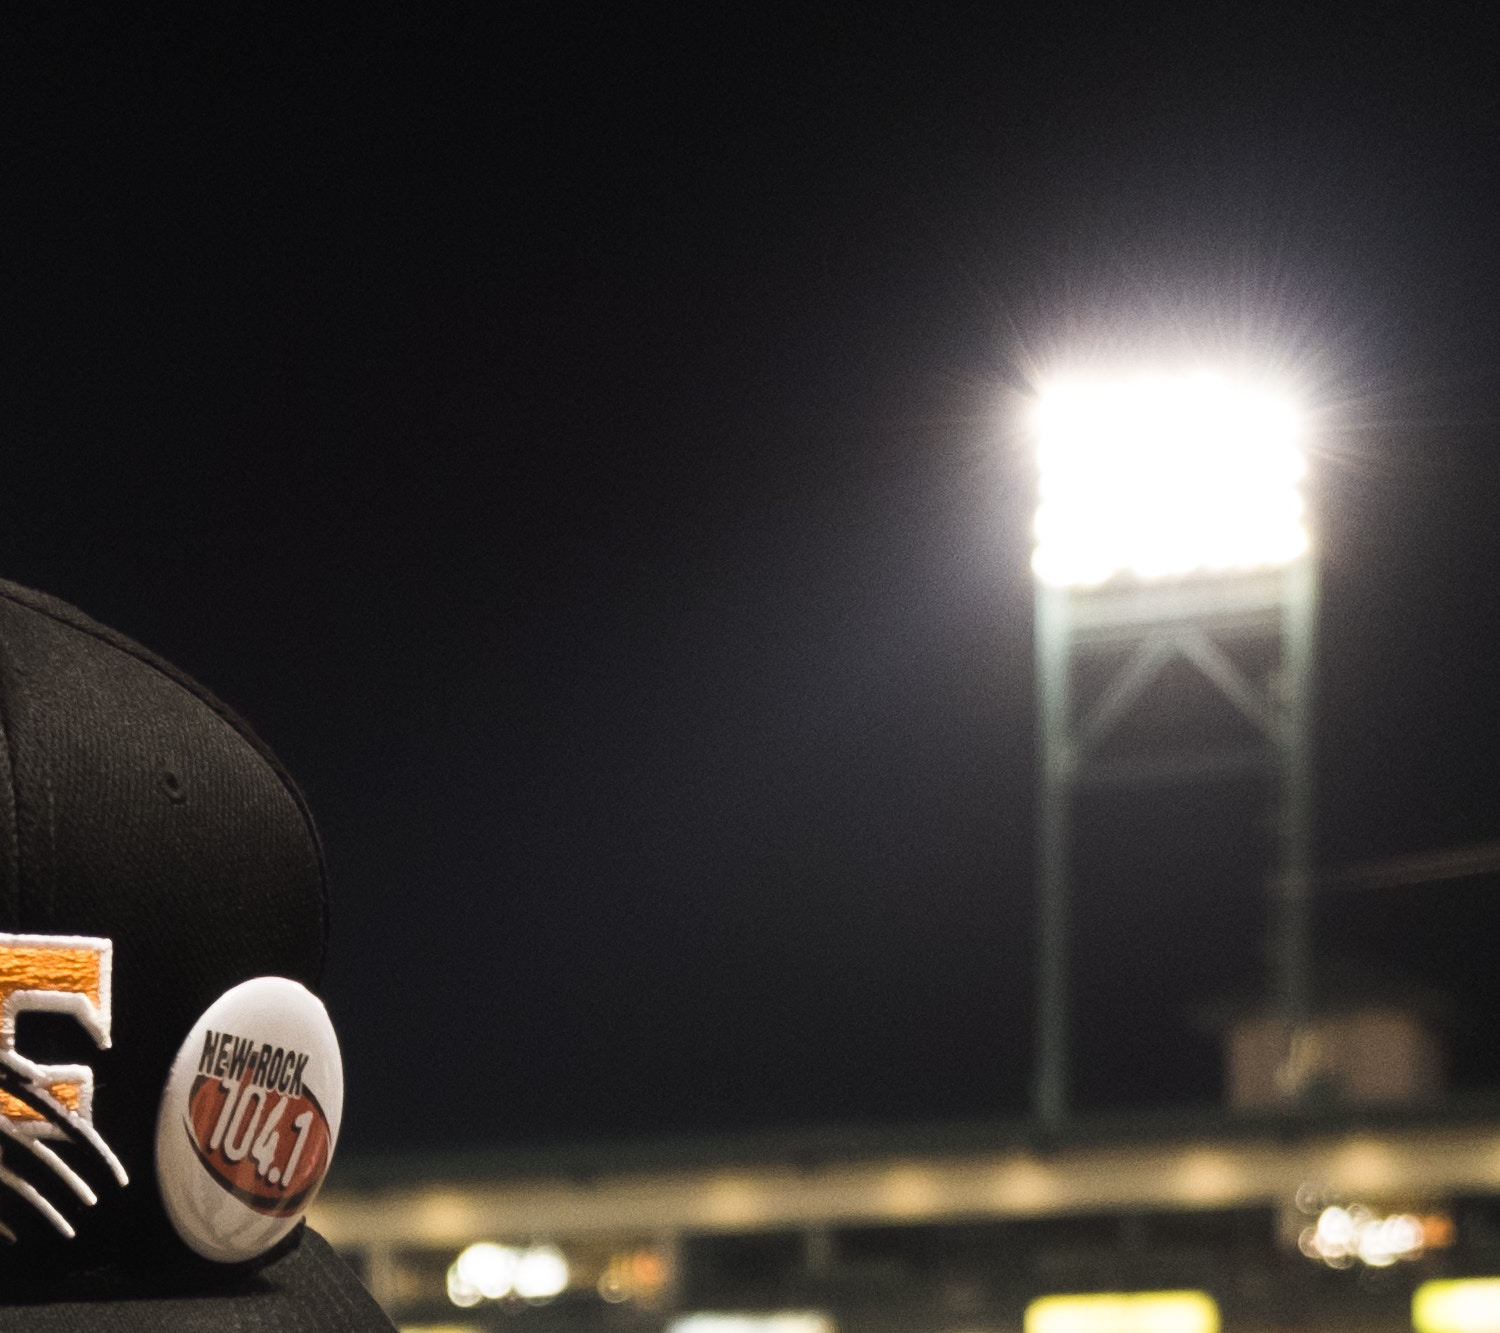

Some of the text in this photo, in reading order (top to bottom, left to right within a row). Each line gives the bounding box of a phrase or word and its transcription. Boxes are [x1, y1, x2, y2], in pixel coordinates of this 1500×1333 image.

[198, 1029, 309, 1096] NEW ROCK
[208, 1078, 314, 1187] 104.1
